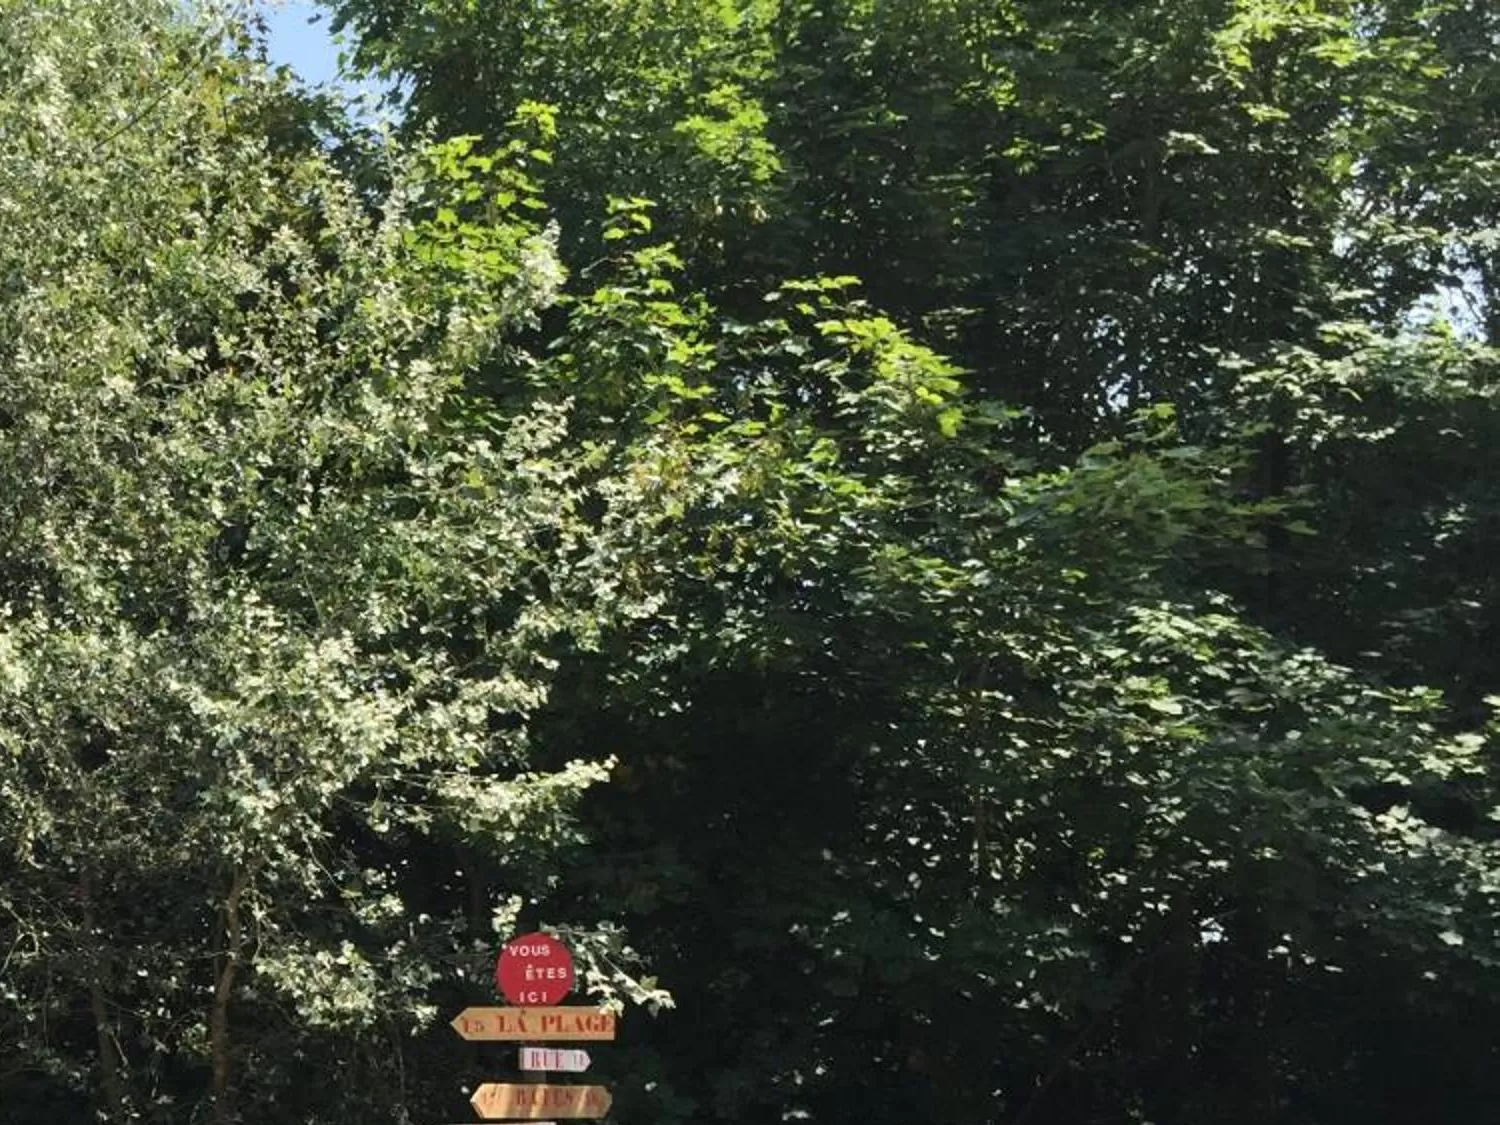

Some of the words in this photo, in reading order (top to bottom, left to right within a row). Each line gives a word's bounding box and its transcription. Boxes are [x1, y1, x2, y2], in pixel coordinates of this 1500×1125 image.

[509, 945, 551, 957] VOUS
[525, 965, 567, 981] ÊTES
[519, 992, 548, 1003] ICI
[497, 1015, 529, 1033] LA
[541, 1014, 613, 1034] PLAGE
[531, 1051, 565, 1068] RUE
